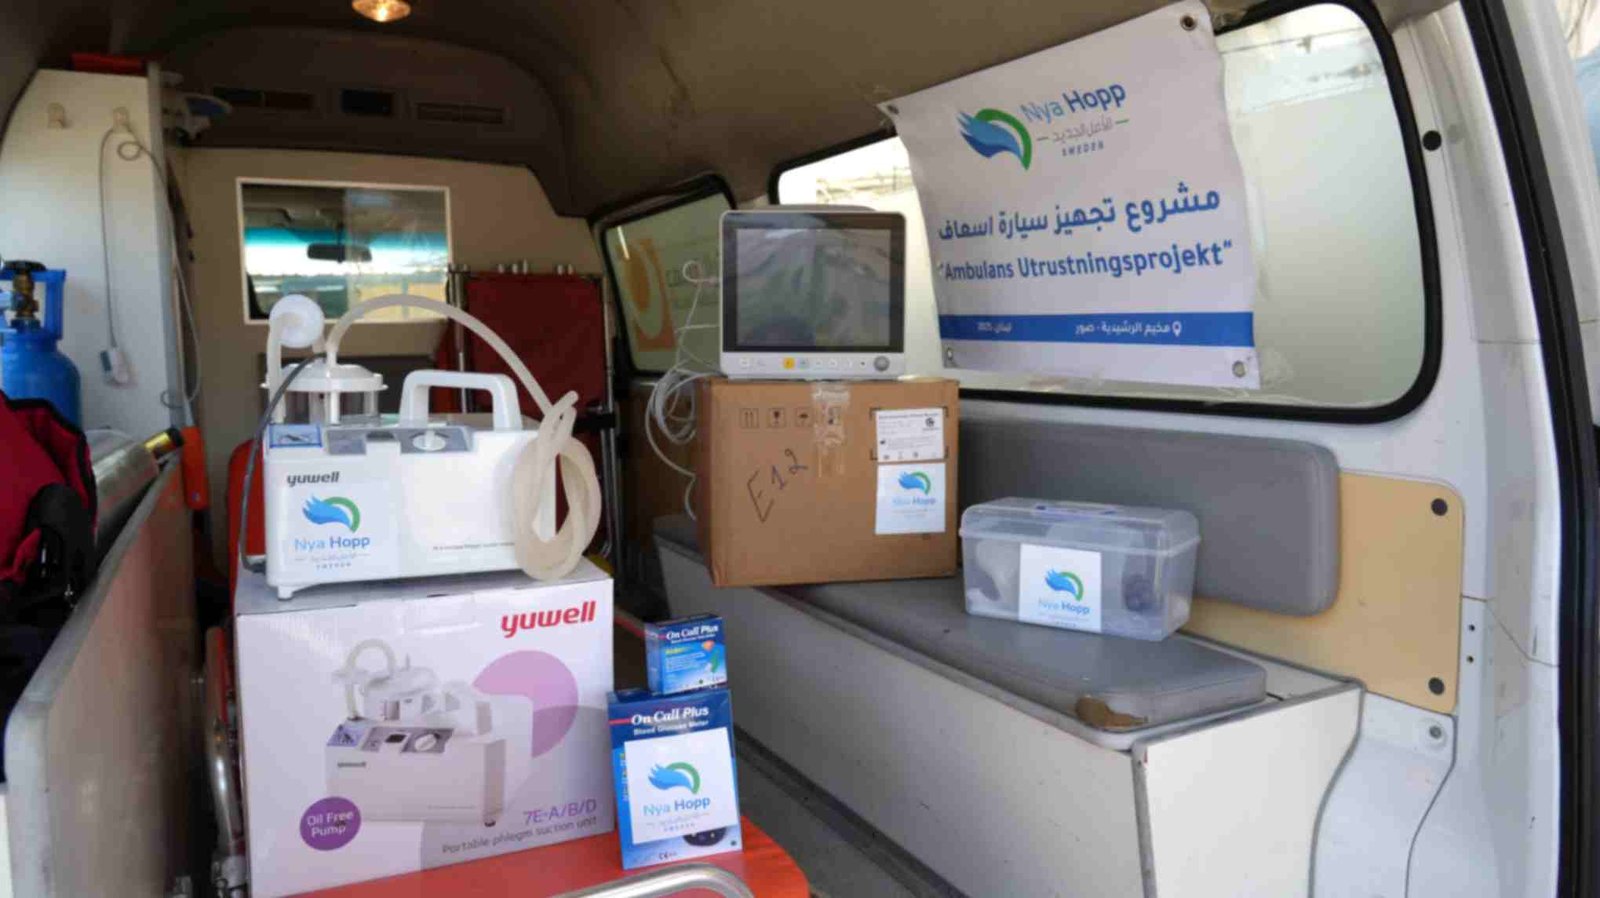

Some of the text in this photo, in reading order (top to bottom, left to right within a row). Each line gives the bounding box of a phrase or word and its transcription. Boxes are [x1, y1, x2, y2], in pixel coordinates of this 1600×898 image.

[1020, 84, 1126, 124] Nya Hopp
[938, 181, 1220, 241] مشروع تجهيز سيارة اسعاف
[287, 471, 340, 488] yuwell
[329, 536, 371, 550] Hopp
[500, 600, 597, 638] yuwell
[666, 631, 680, 641] On
[681, 626, 699, 638] Call
[700, 624, 719, 634] Plus
[631, 706, 709, 726] On Call Plus
[523, 798, 597, 825] 7E-A/B/D
[674, 797, 711, 812] Hopp
[307, 811, 354, 827] Oil Free
[311, 825, 347, 838] Pump
[442, 836, 490, 853] Portable
[492, 829, 533, 846] phlegm
[577, 816, 597, 829] unit
